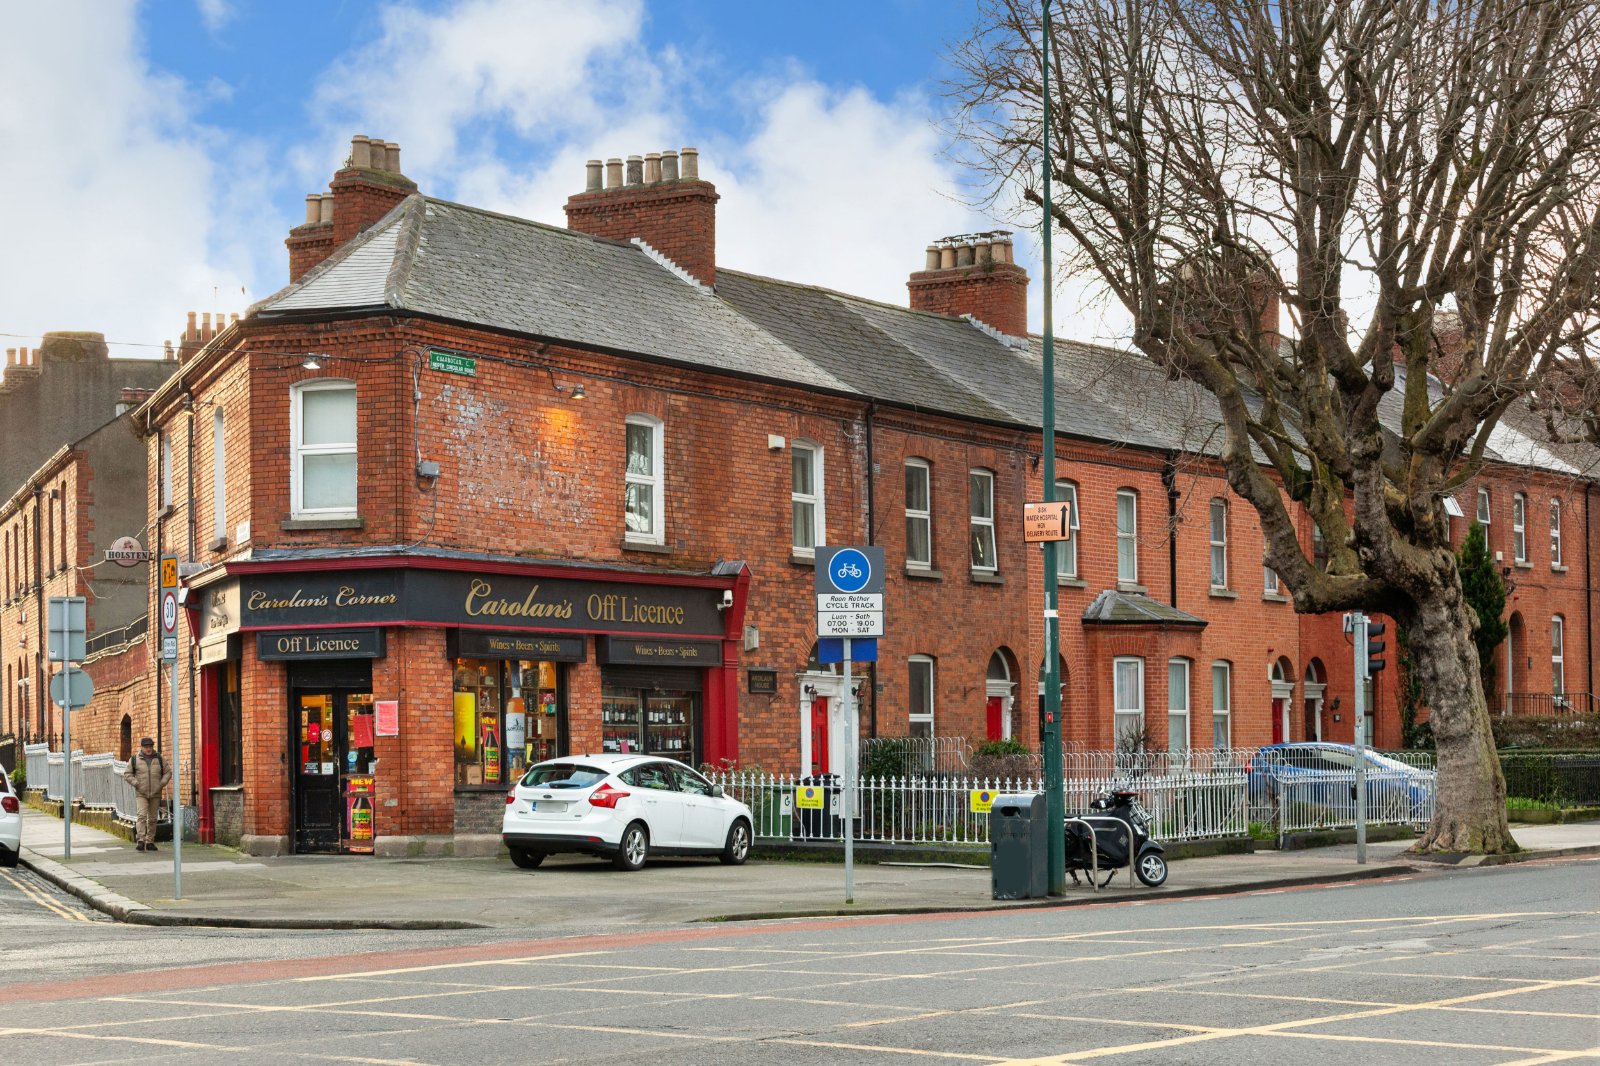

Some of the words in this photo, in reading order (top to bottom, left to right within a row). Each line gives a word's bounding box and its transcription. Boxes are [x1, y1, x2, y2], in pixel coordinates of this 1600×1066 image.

[108, 551, 148, 560] HOLSTEN
[247, 590, 329, 611] Carolan's
[335, 586, 398, 606] Corner
[465, 578, 573, 619] Carolan's
[586, 594, 618, 620] Off
[620, 596, 685, 625] Licence
[166, 602, 174, 618] 30
[277, 636, 302, 653] Off
[306, 636, 360, 652] Licence
[490, 638, 510, 650] Wines
[516, 640, 534, 651] Beers
[540, 641, 560, 654] Spirits
[635, 644, 654, 656] Wines
[658, 646, 674, 656] Beers
[679, 646, 698, 659] Spirits
